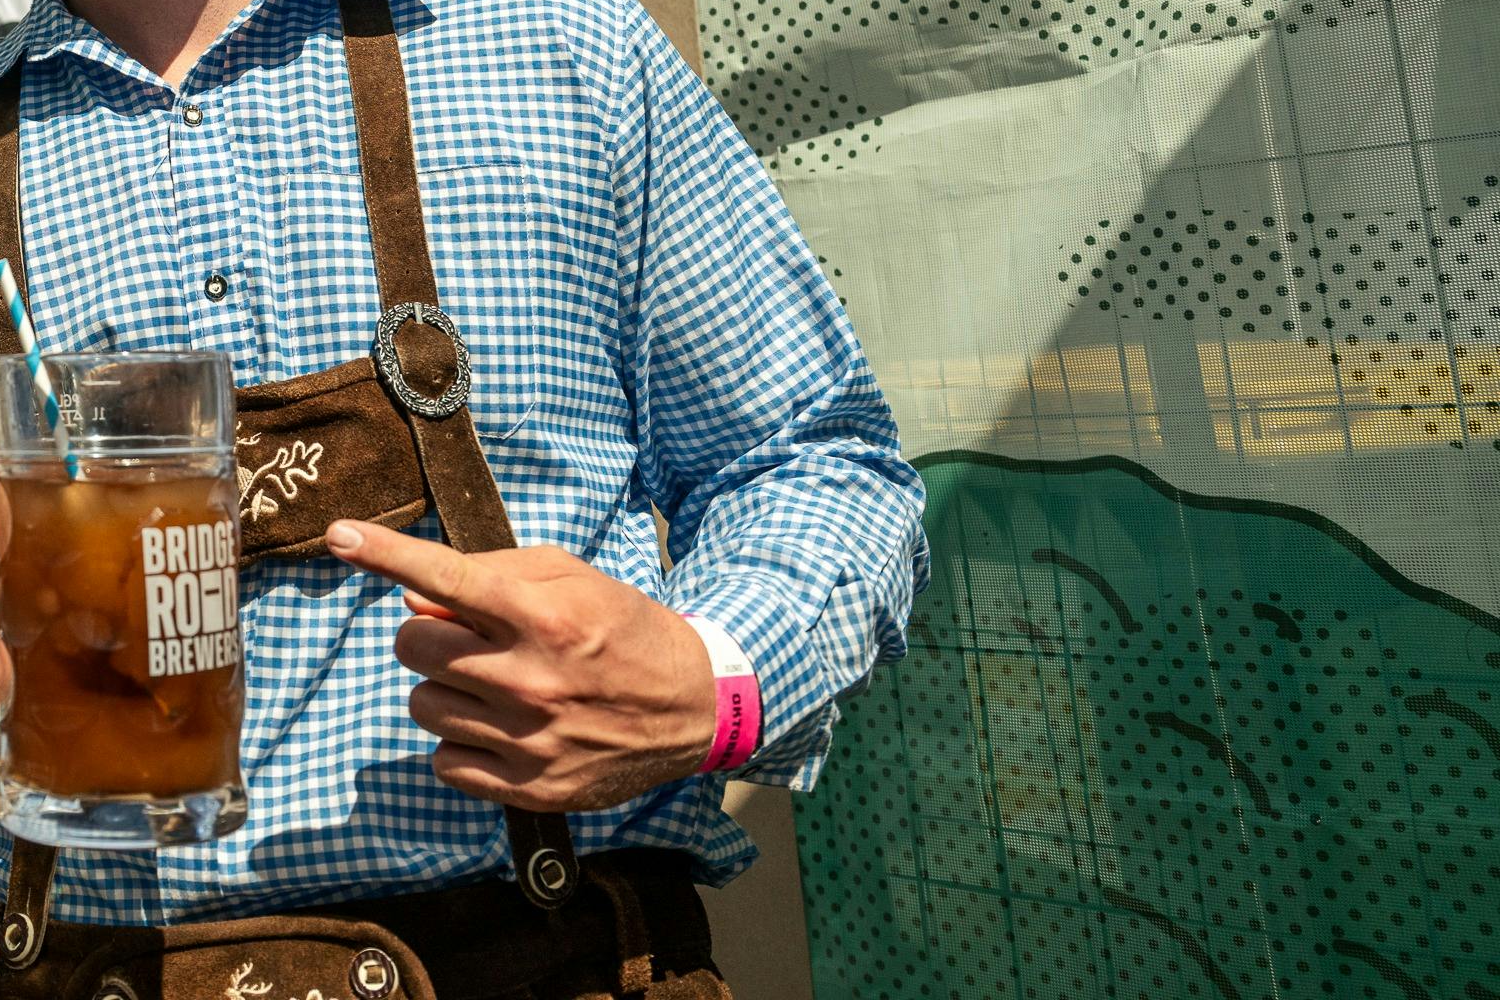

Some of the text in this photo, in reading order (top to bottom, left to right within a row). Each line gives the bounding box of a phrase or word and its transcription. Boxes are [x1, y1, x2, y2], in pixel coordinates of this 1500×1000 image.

[141, 519, 236, 575] BRIDGE
[144, 566, 238, 639] ROAD
[148, 629, 239, 677] BREWERS
